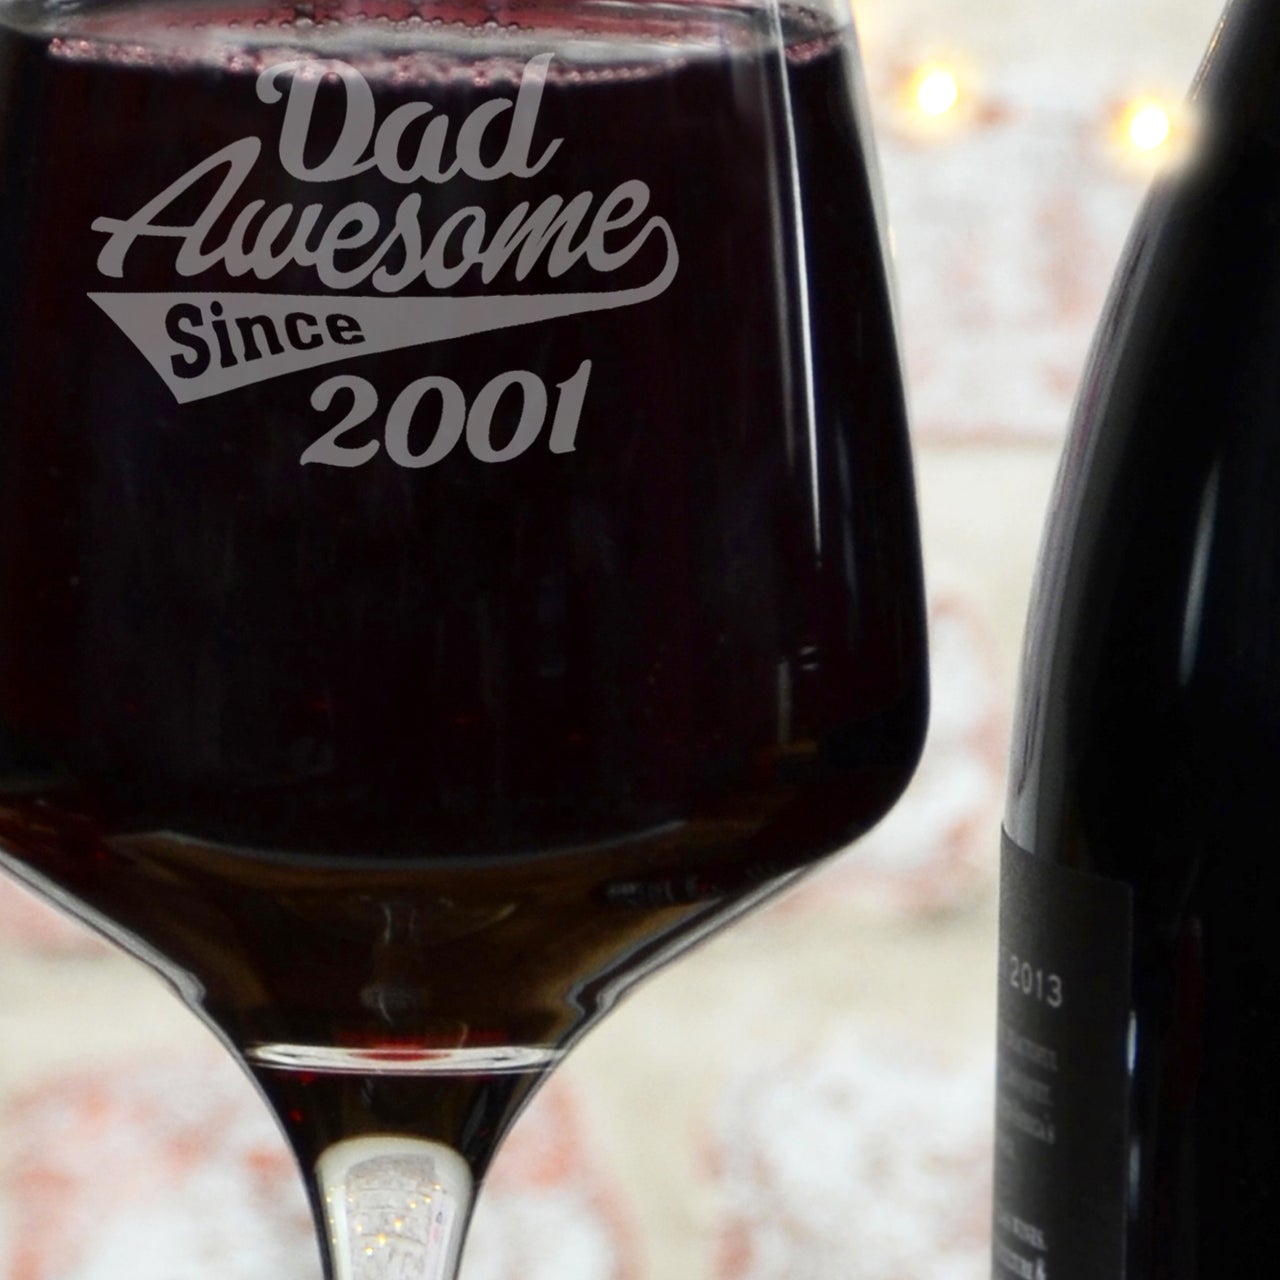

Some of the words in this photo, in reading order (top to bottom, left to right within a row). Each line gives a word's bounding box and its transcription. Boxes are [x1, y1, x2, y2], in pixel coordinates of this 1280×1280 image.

[255, 52, 565, 184] Dad
[90, 136, 679, 293] Awesome
[164, 300, 366, 380] Since
[300, 359, 592, 469] 2001
[1009, 955, 1064, 1009] 2013
